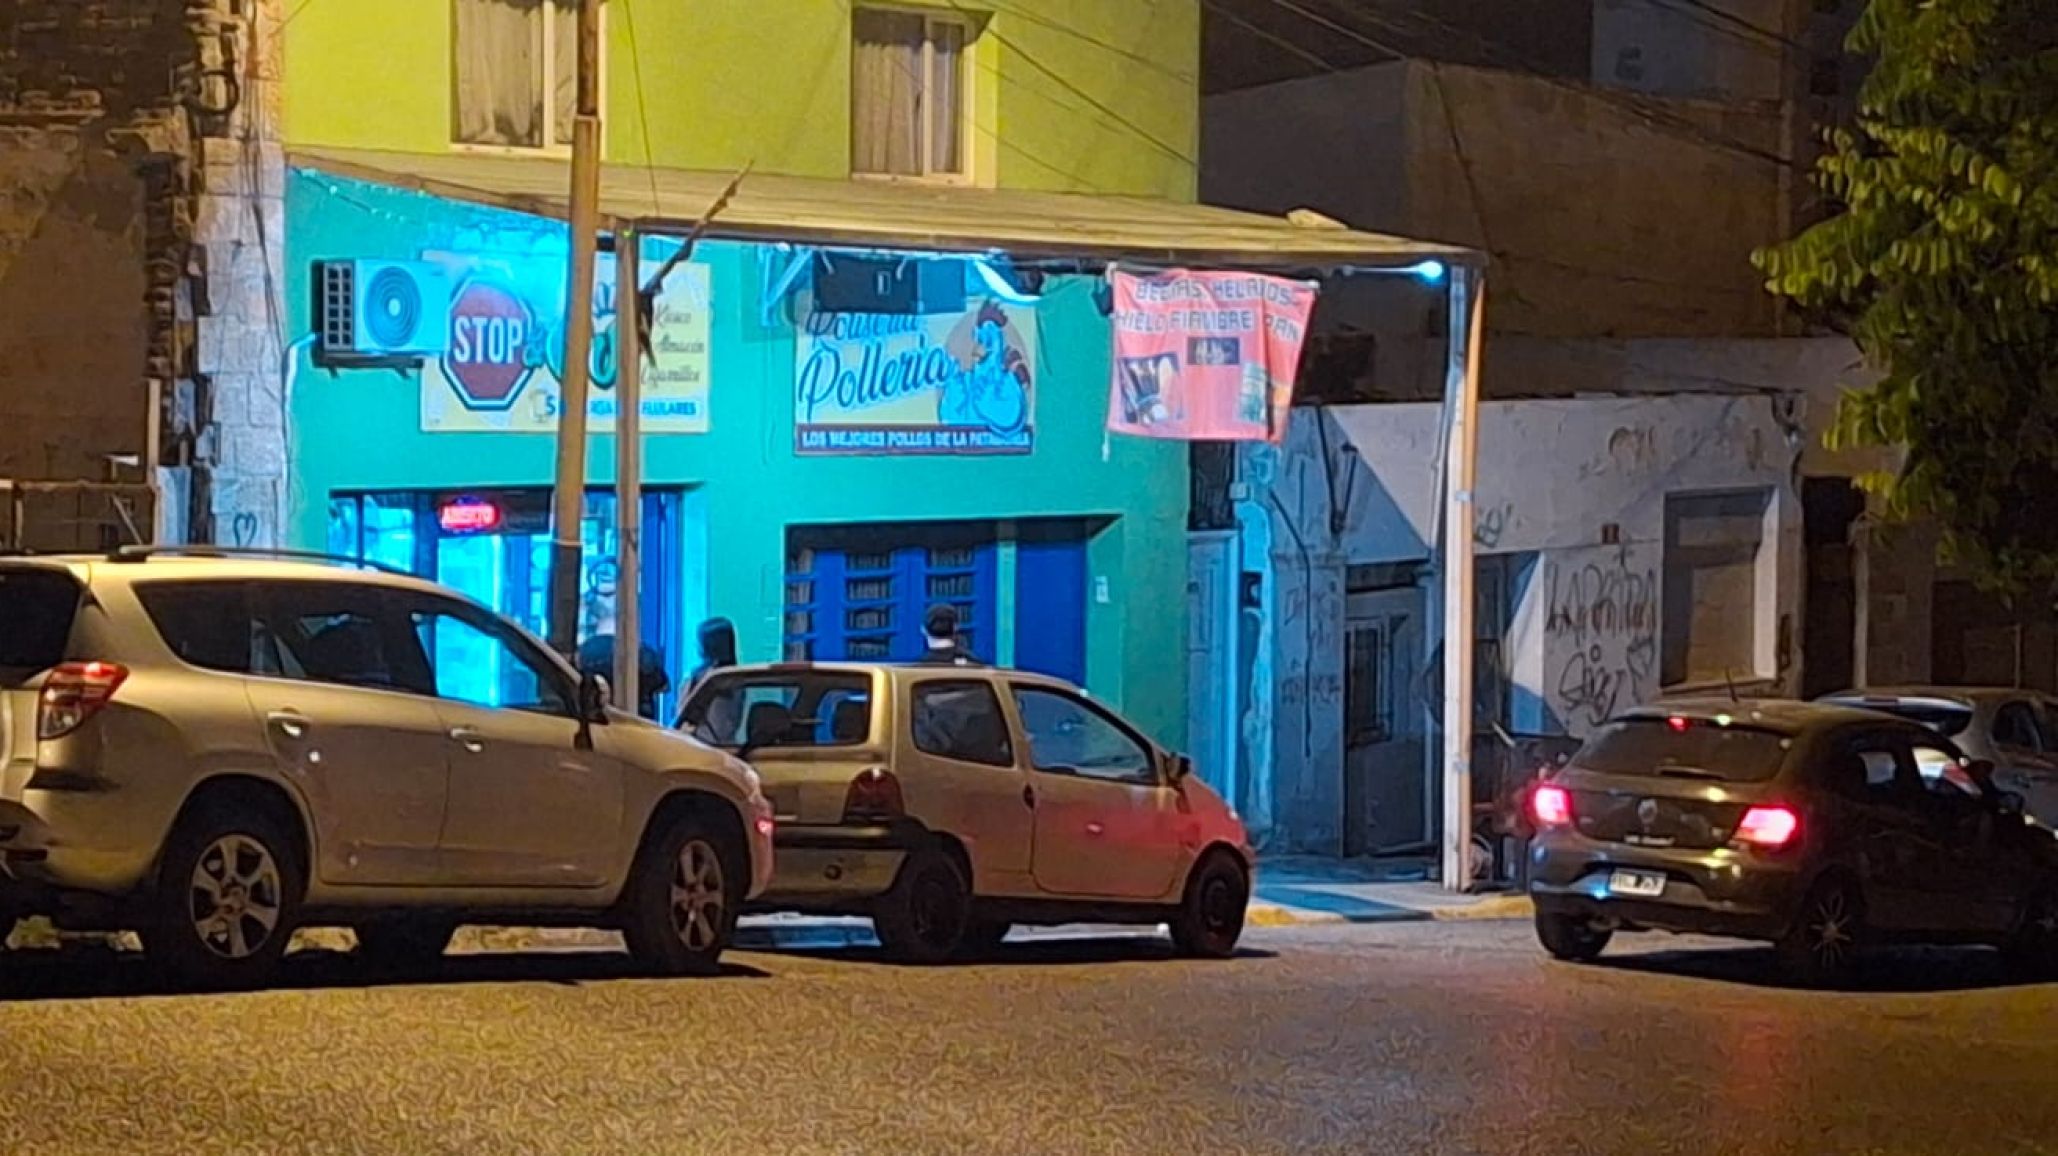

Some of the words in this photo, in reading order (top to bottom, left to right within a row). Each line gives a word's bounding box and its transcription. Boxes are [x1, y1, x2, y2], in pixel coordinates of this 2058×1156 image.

[453, 315, 524, 364] STOP
[802, 430, 826, 448] LOS
[888, 430, 931, 446] POLLOS
[934, 430, 951, 446] DE
[953, 430, 967, 446] LA
